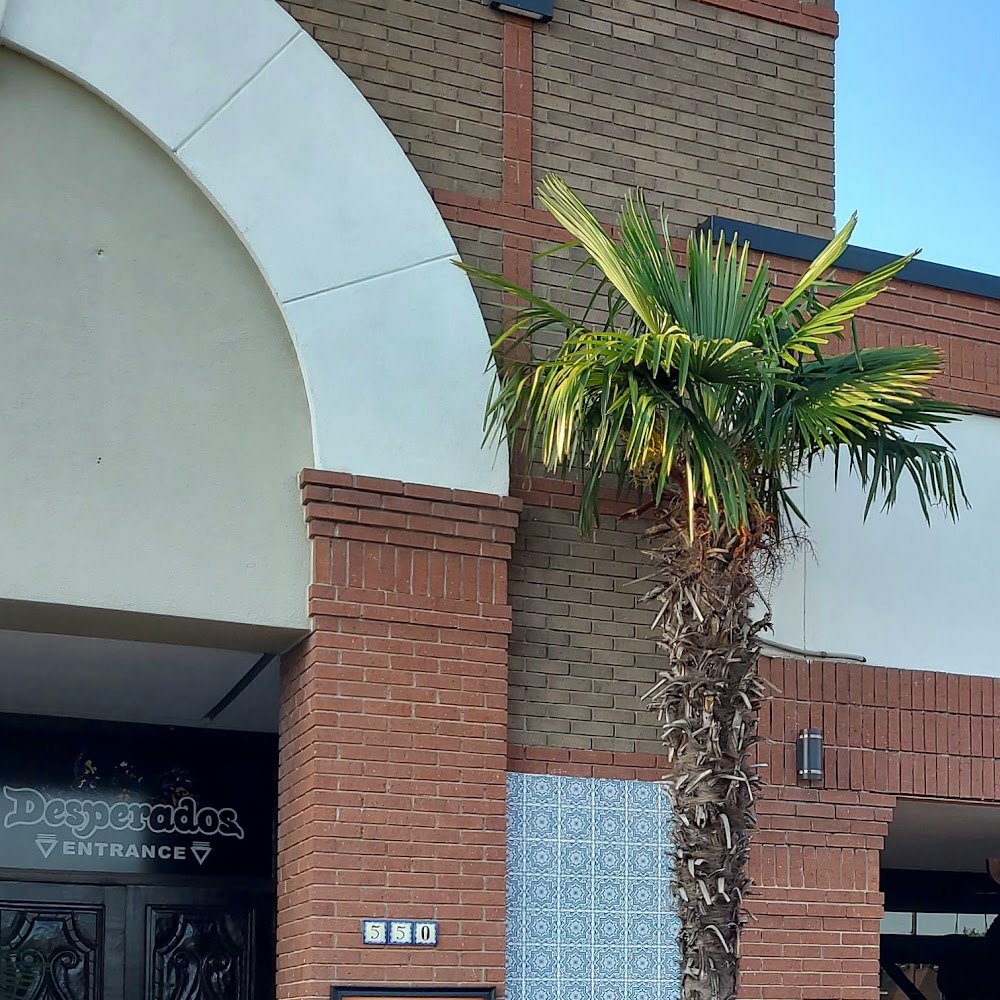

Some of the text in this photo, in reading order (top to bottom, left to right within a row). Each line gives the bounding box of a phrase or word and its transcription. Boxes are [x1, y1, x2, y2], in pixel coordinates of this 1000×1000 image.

[3, 785, 244, 839] Desperados
[62, 841, 187, 860] ENTRANCE
[370, 924, 431, 941] 550
